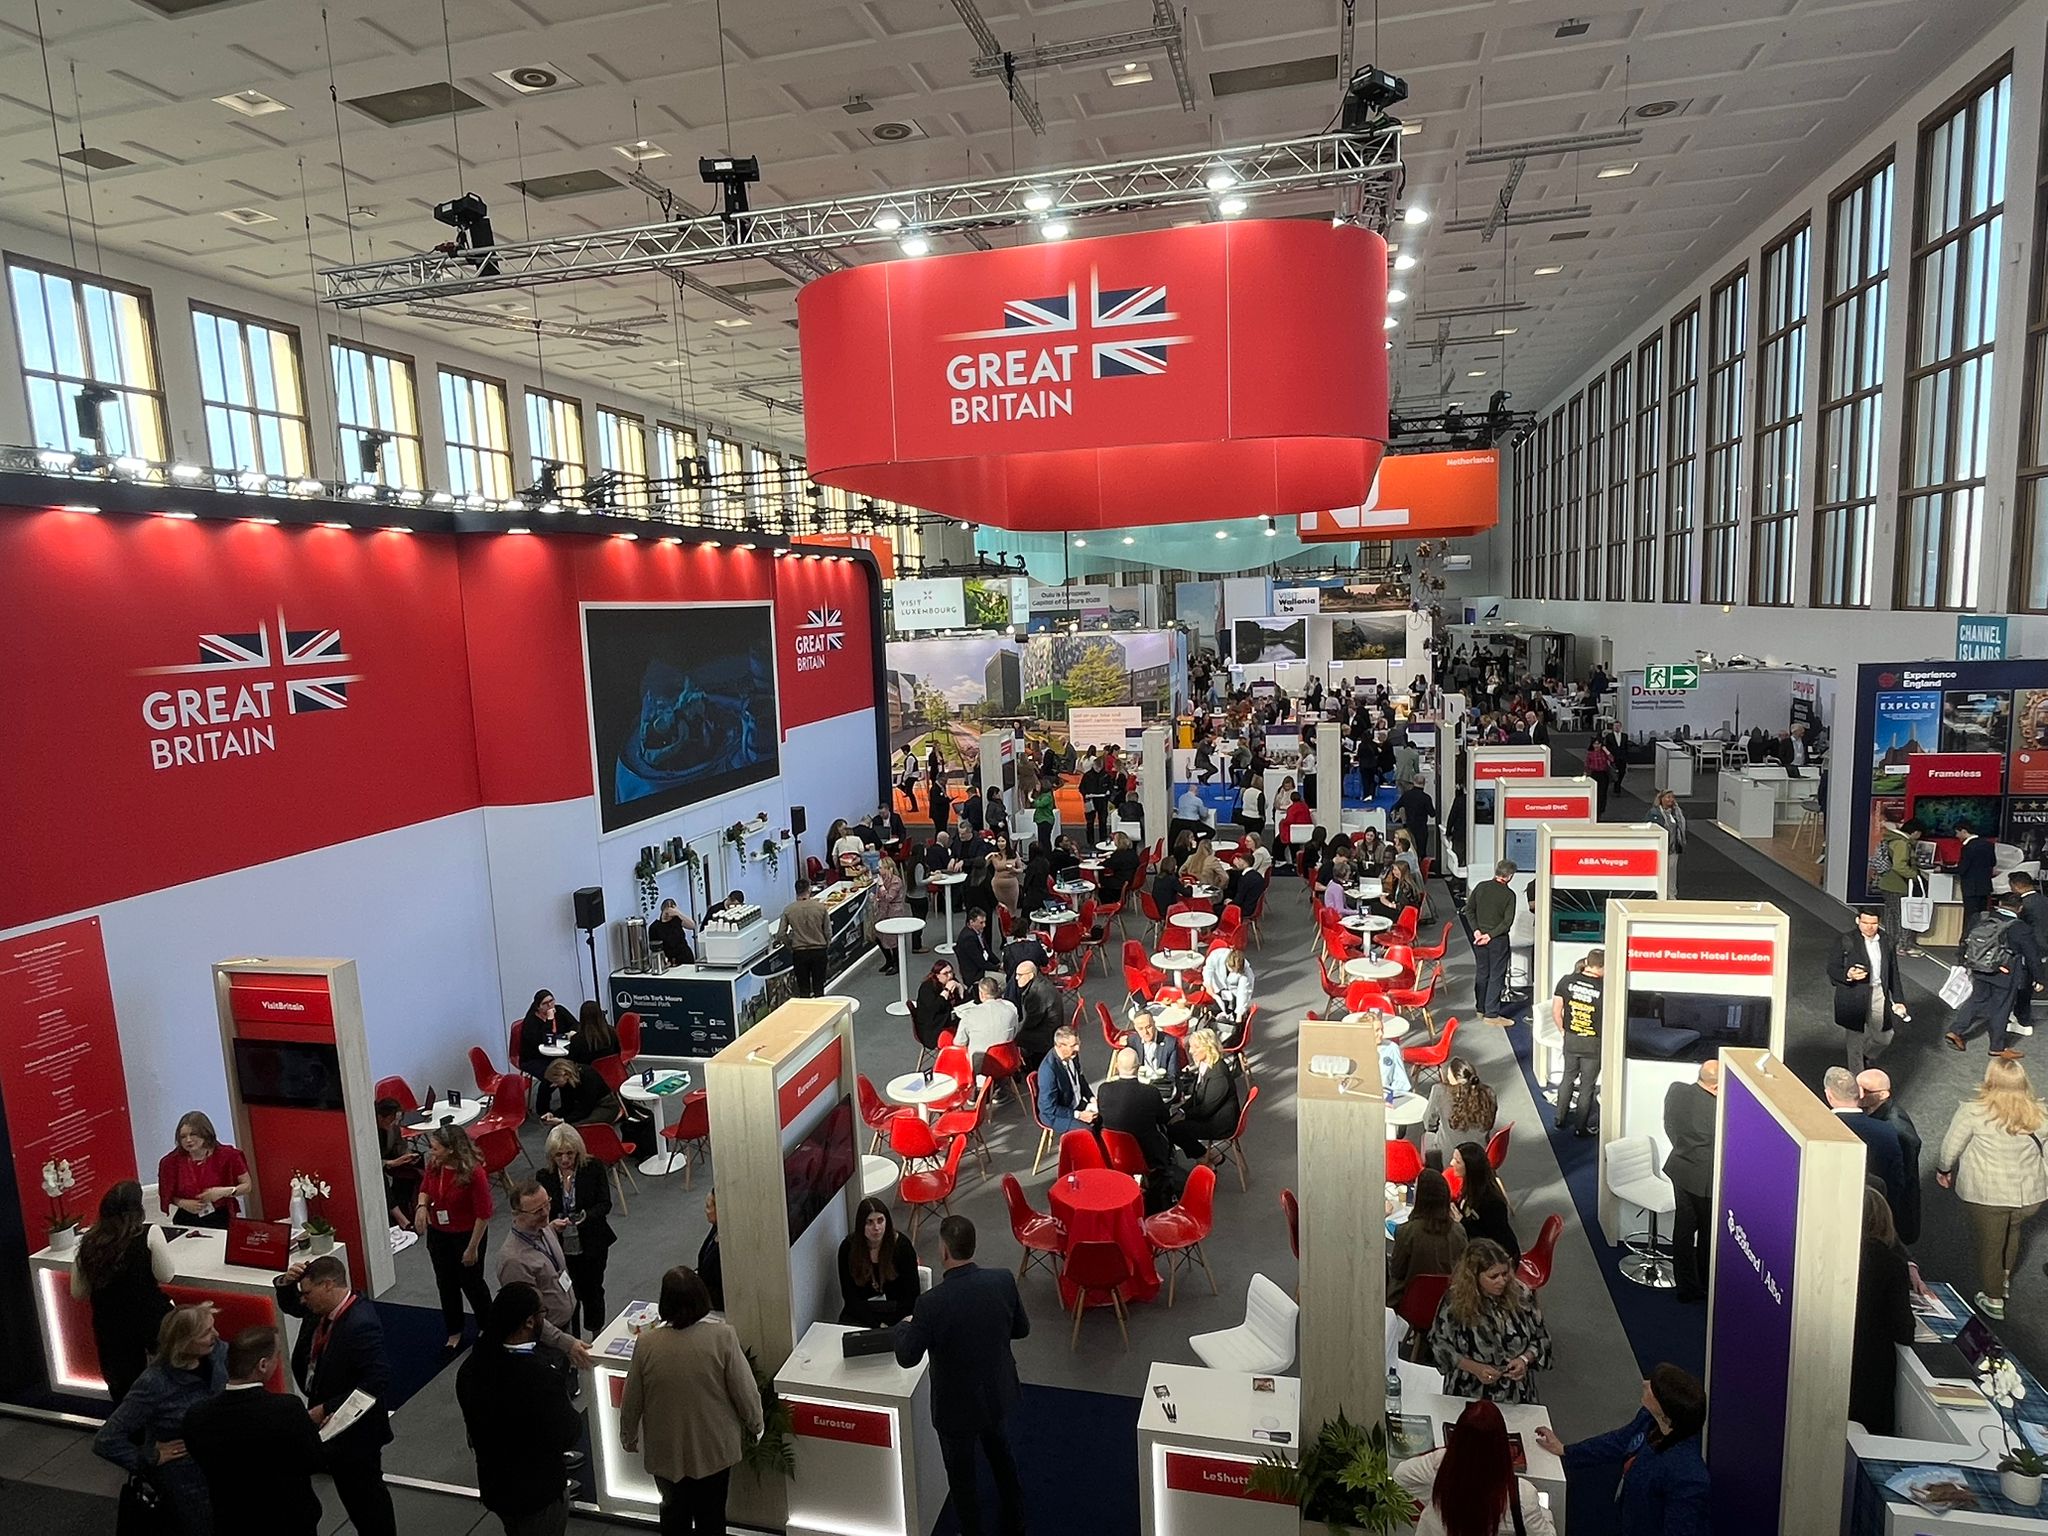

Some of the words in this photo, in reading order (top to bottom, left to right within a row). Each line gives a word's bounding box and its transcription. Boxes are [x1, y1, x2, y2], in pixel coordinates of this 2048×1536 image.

[946, 345, 1079, 391] GREAT
[950, 388, 1073, 425] BRITAIN
[1447, 455, 1495, 466] Netherlands
[901, 599, 921, 607] VISIT
[1278, 598, 1316, 606] Wallonia
[901, 606, 957, 616] LUXEMBOURG
[1959, 624, 2001, 644] CHANNEL
[795, 633, 825, 655] GREAT
[1958, 643, 2001, 661] ISLANDS
[797, 654, 826, 672] BRITAIN
[1903, 671, 1957, 681] Experience
[1903, 679, 1942, 689] England
[142, 681, 275, 731] GREAT
[1880, 701, 1936, 711] EXPLORE
[150, 724, 276, 770] BRITAIN
[1928, 769, 1982, 778] Frameless
[1578, 858, 1600, 866] ABBA
[1600, 858, 1629, 867] Voyage
[1628, 948, 1663, 959] Strand
[1664, 950, 1699, 960] Palace
[1700, 951, 1730, 961] Hotel
[1731, 952, 1771, 962] London
[261, 1001, 305, 1011] VisitBritain
[1734, 1226, 1761, 1273] Scotland
[1763, 1270, 1782, 1305] Alba
[813, 1415, 857, 1430] Eurostar
[1202, 1470, 1250, 1485] LeShutt
